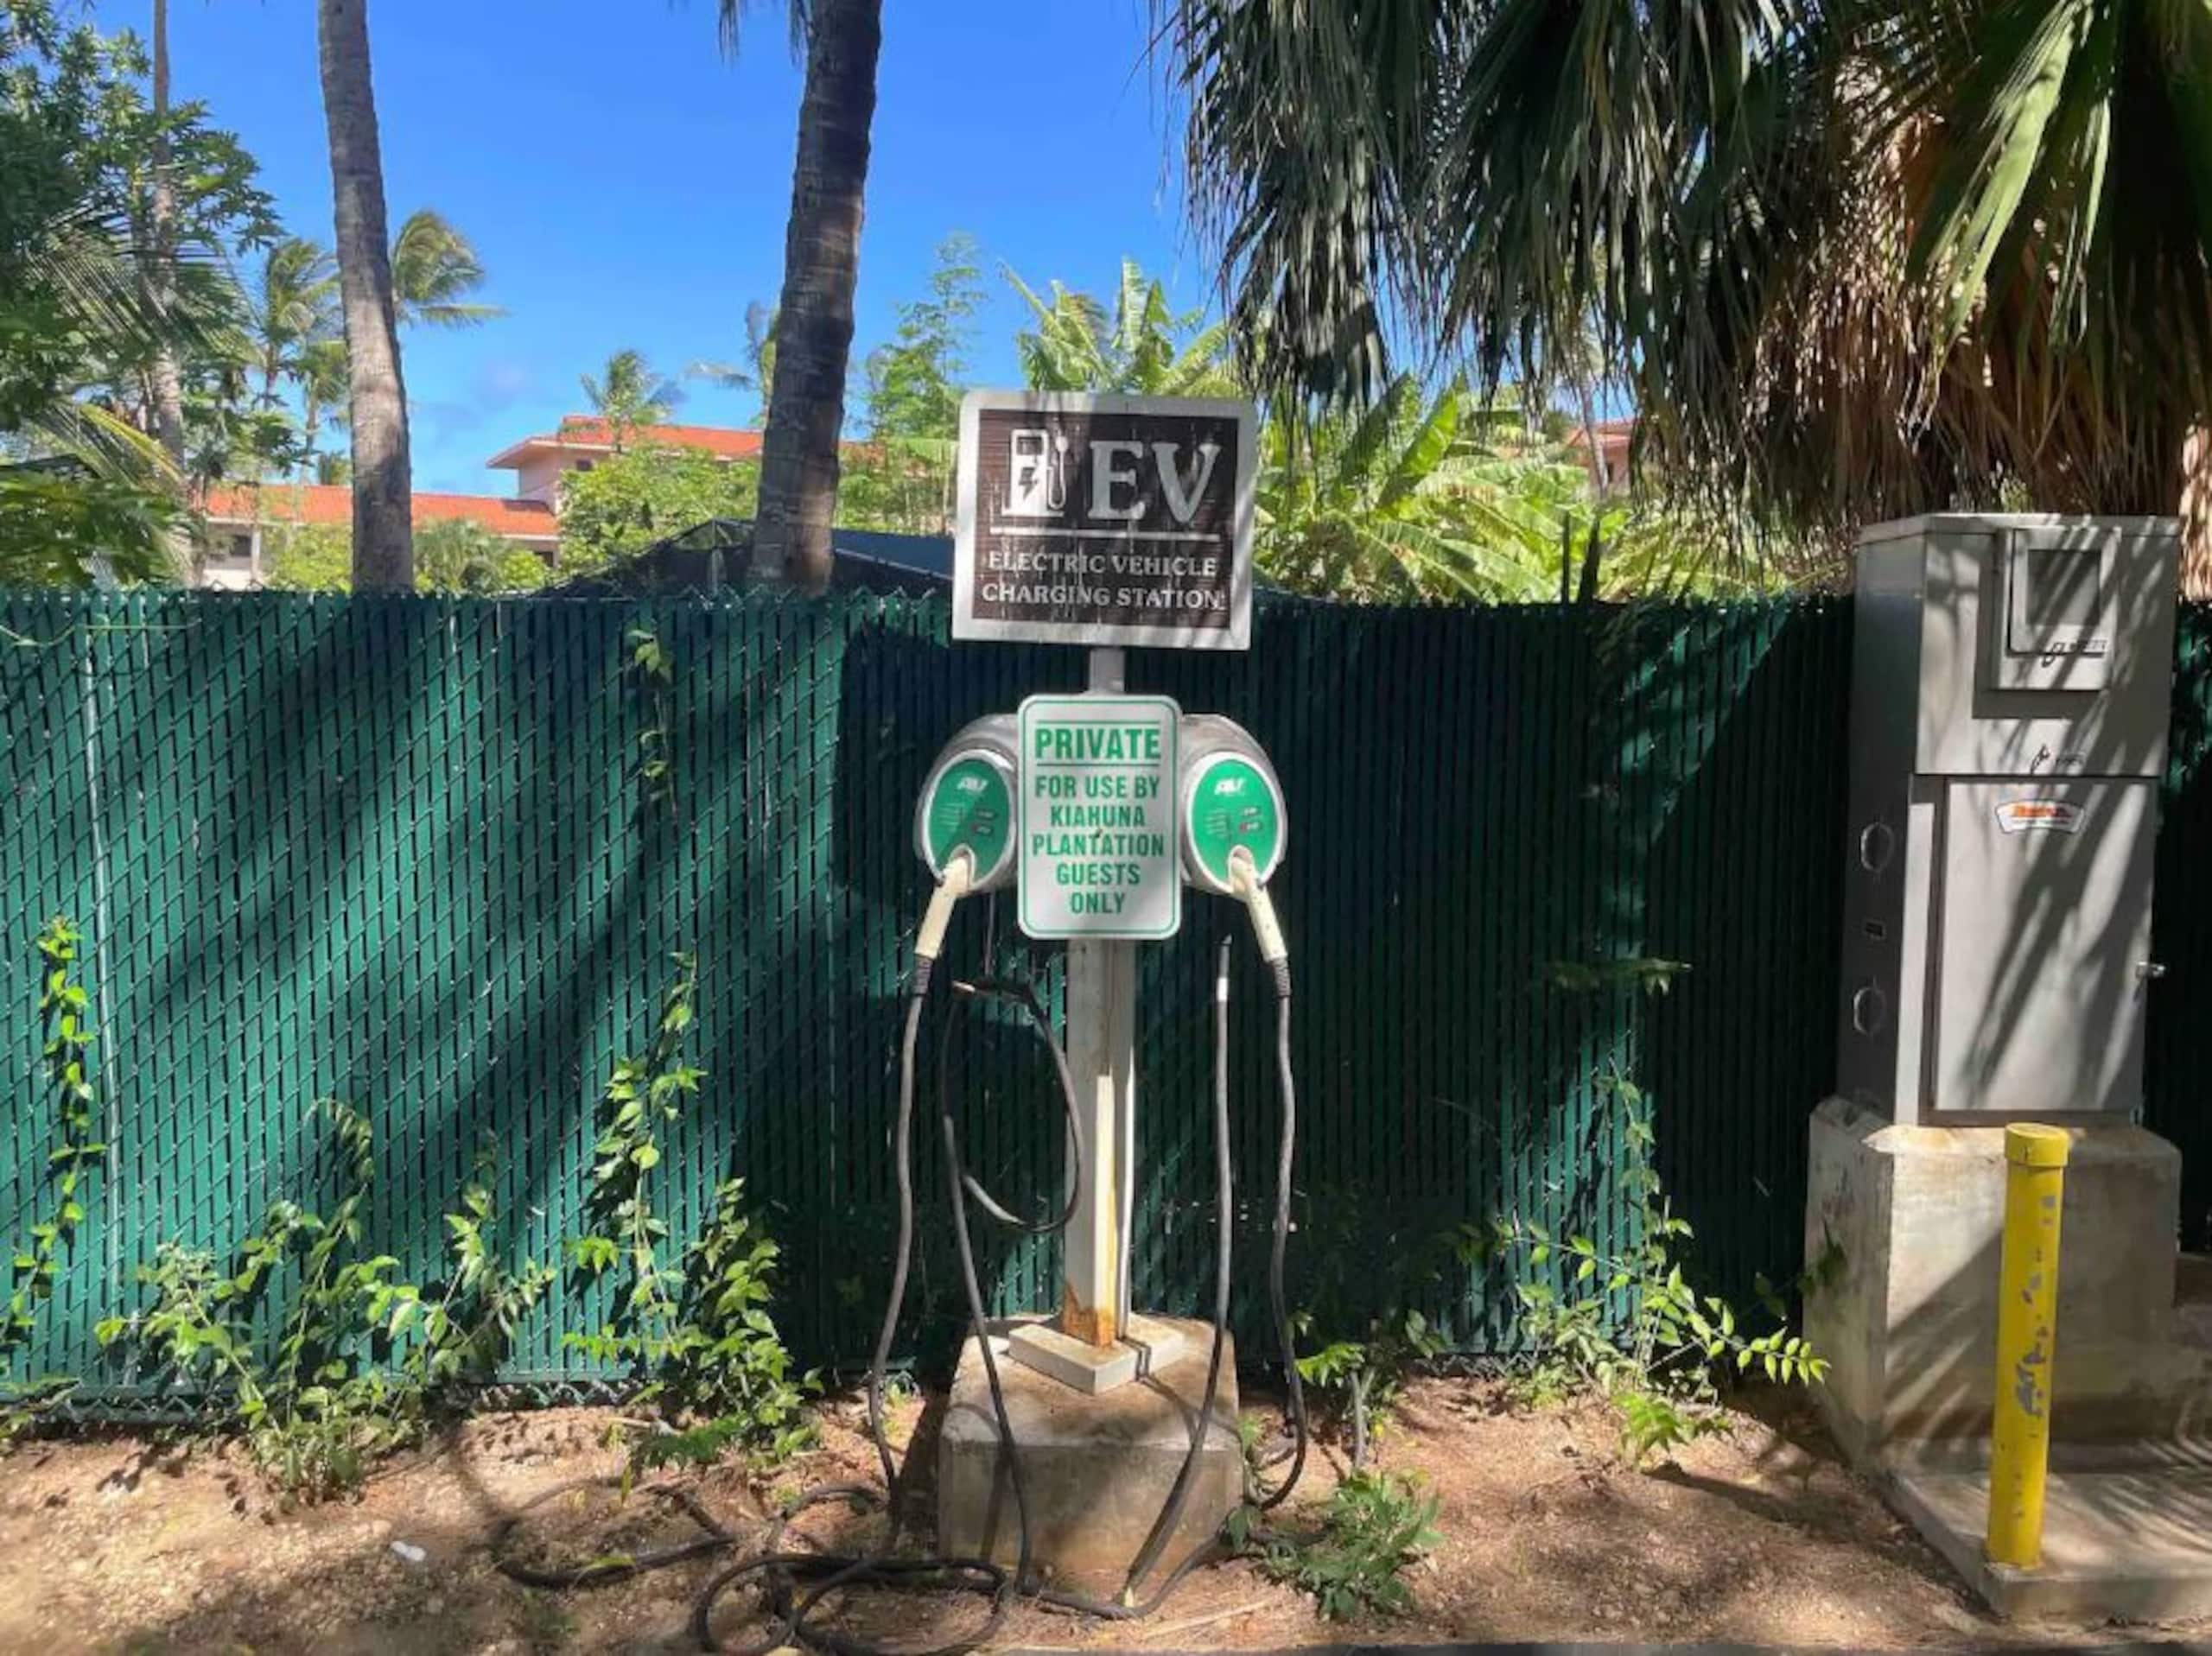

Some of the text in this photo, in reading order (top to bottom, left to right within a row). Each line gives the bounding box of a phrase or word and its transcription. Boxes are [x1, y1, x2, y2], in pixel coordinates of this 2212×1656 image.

[1088, 441, 1221, 523] EV
[988, 550, 1217, 577] ELECTRIC VEHICLE
[982, 583, 1225, 610] CHARGING STATION
[1035, 728, 1161, 759] PRIVATE
[1036, 776, 1160, 799] FOR USE BY
[1050, 805, 1146, 827] KIAHUNA
[1033, 834, 1164, 856] PLANTATION
[1056, 864, 1141, 885] GUESTS
[1070, 892, 1127, 914] ONLY
